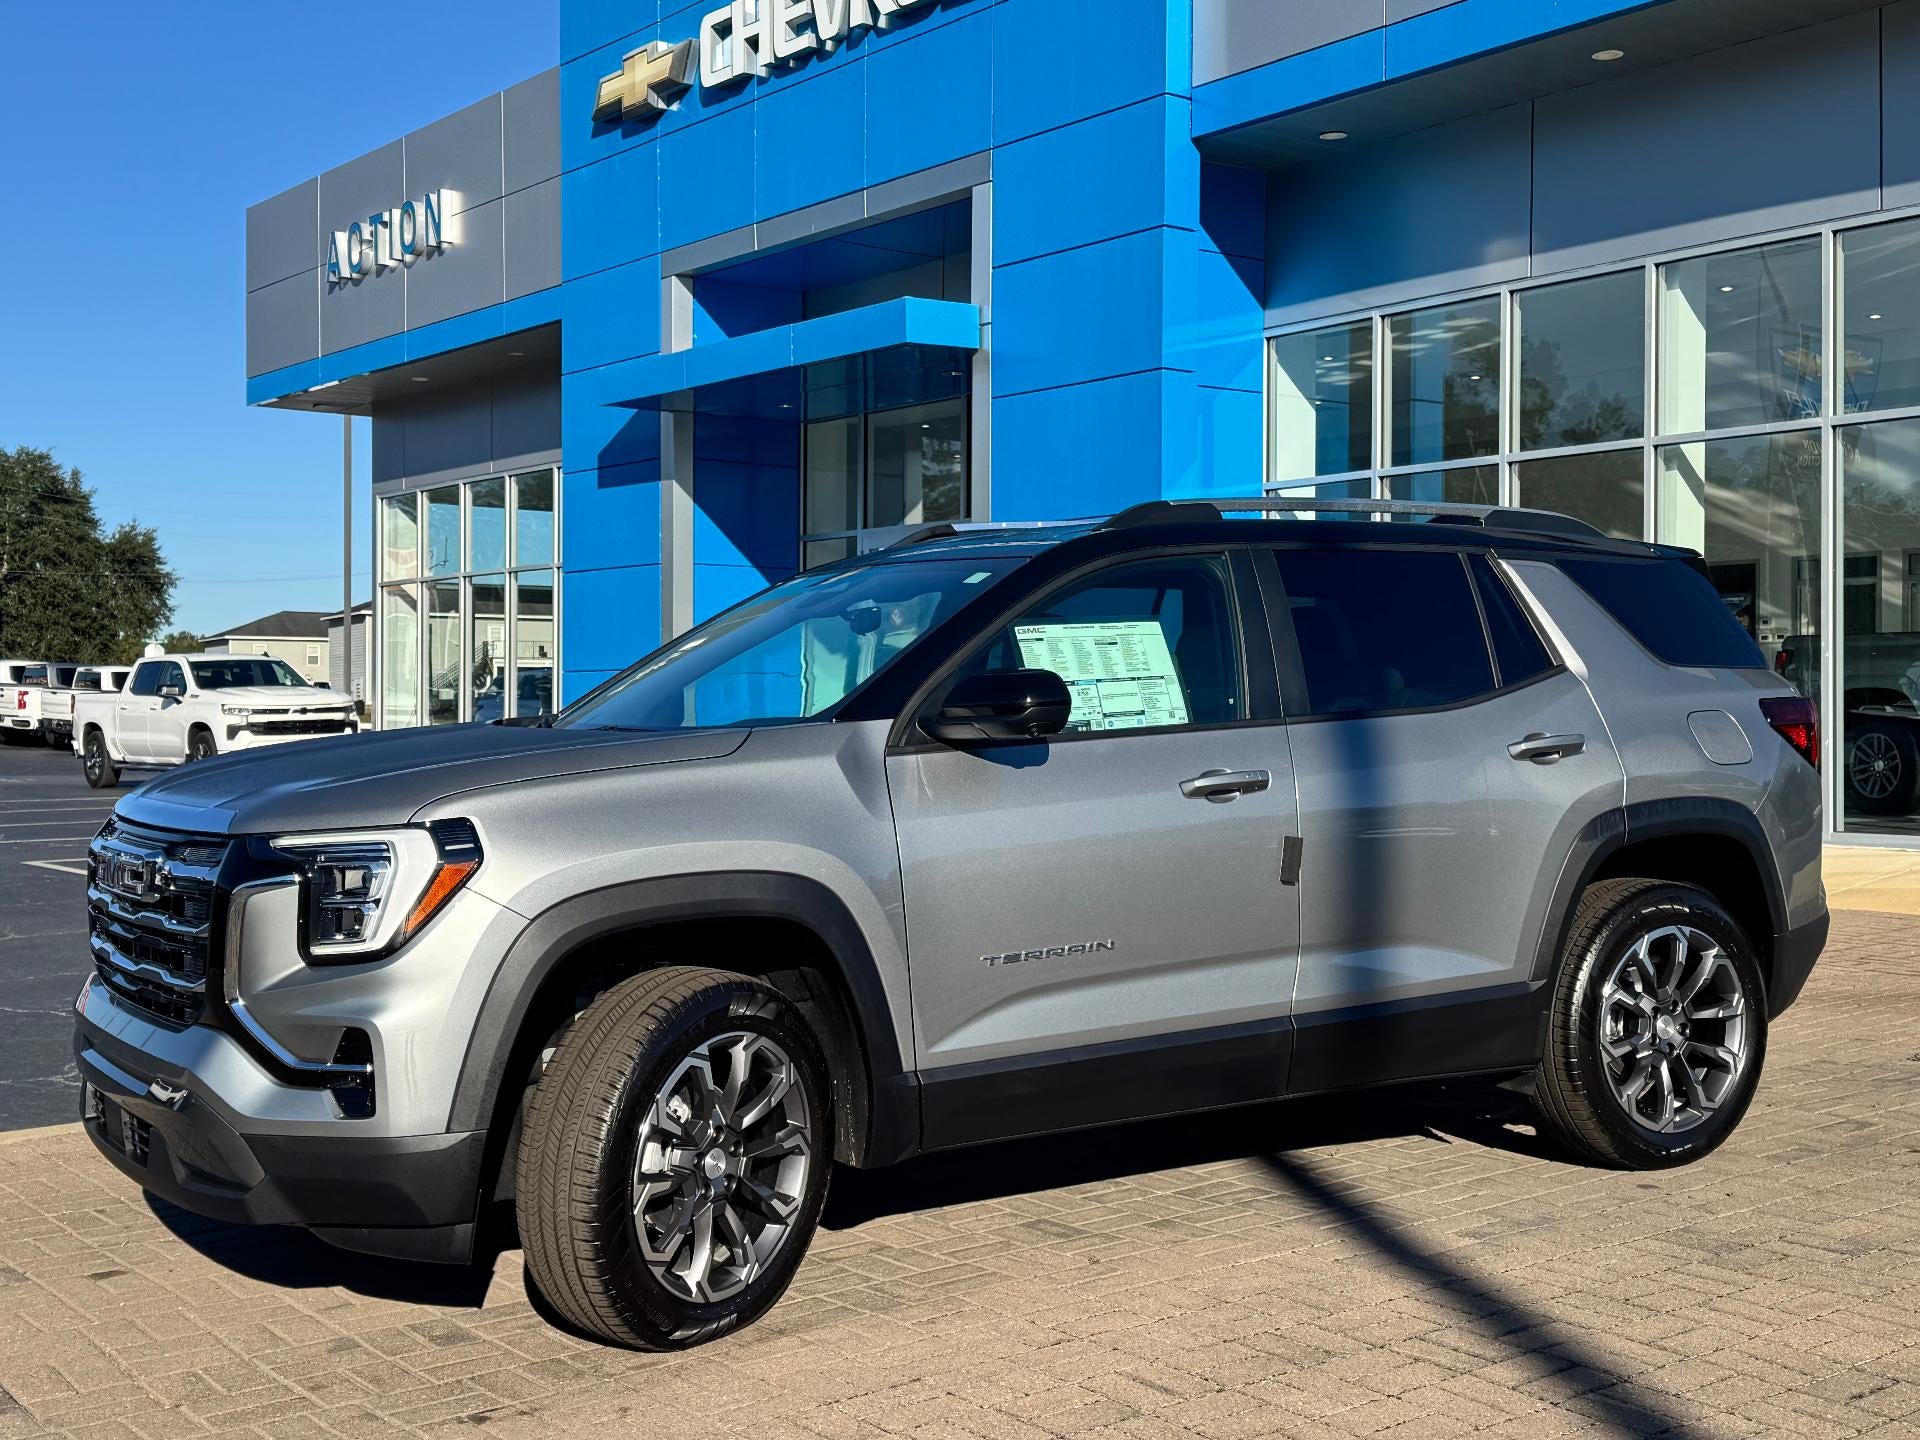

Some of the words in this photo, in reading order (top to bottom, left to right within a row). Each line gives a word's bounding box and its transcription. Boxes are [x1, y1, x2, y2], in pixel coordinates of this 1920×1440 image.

[700, 0, 920, 88] CHEV
[326, 188, 460, 284] ACTION
[1017, 627, 1047, 635] GMC
[979, 938, 1115, 968] TERRAIN
